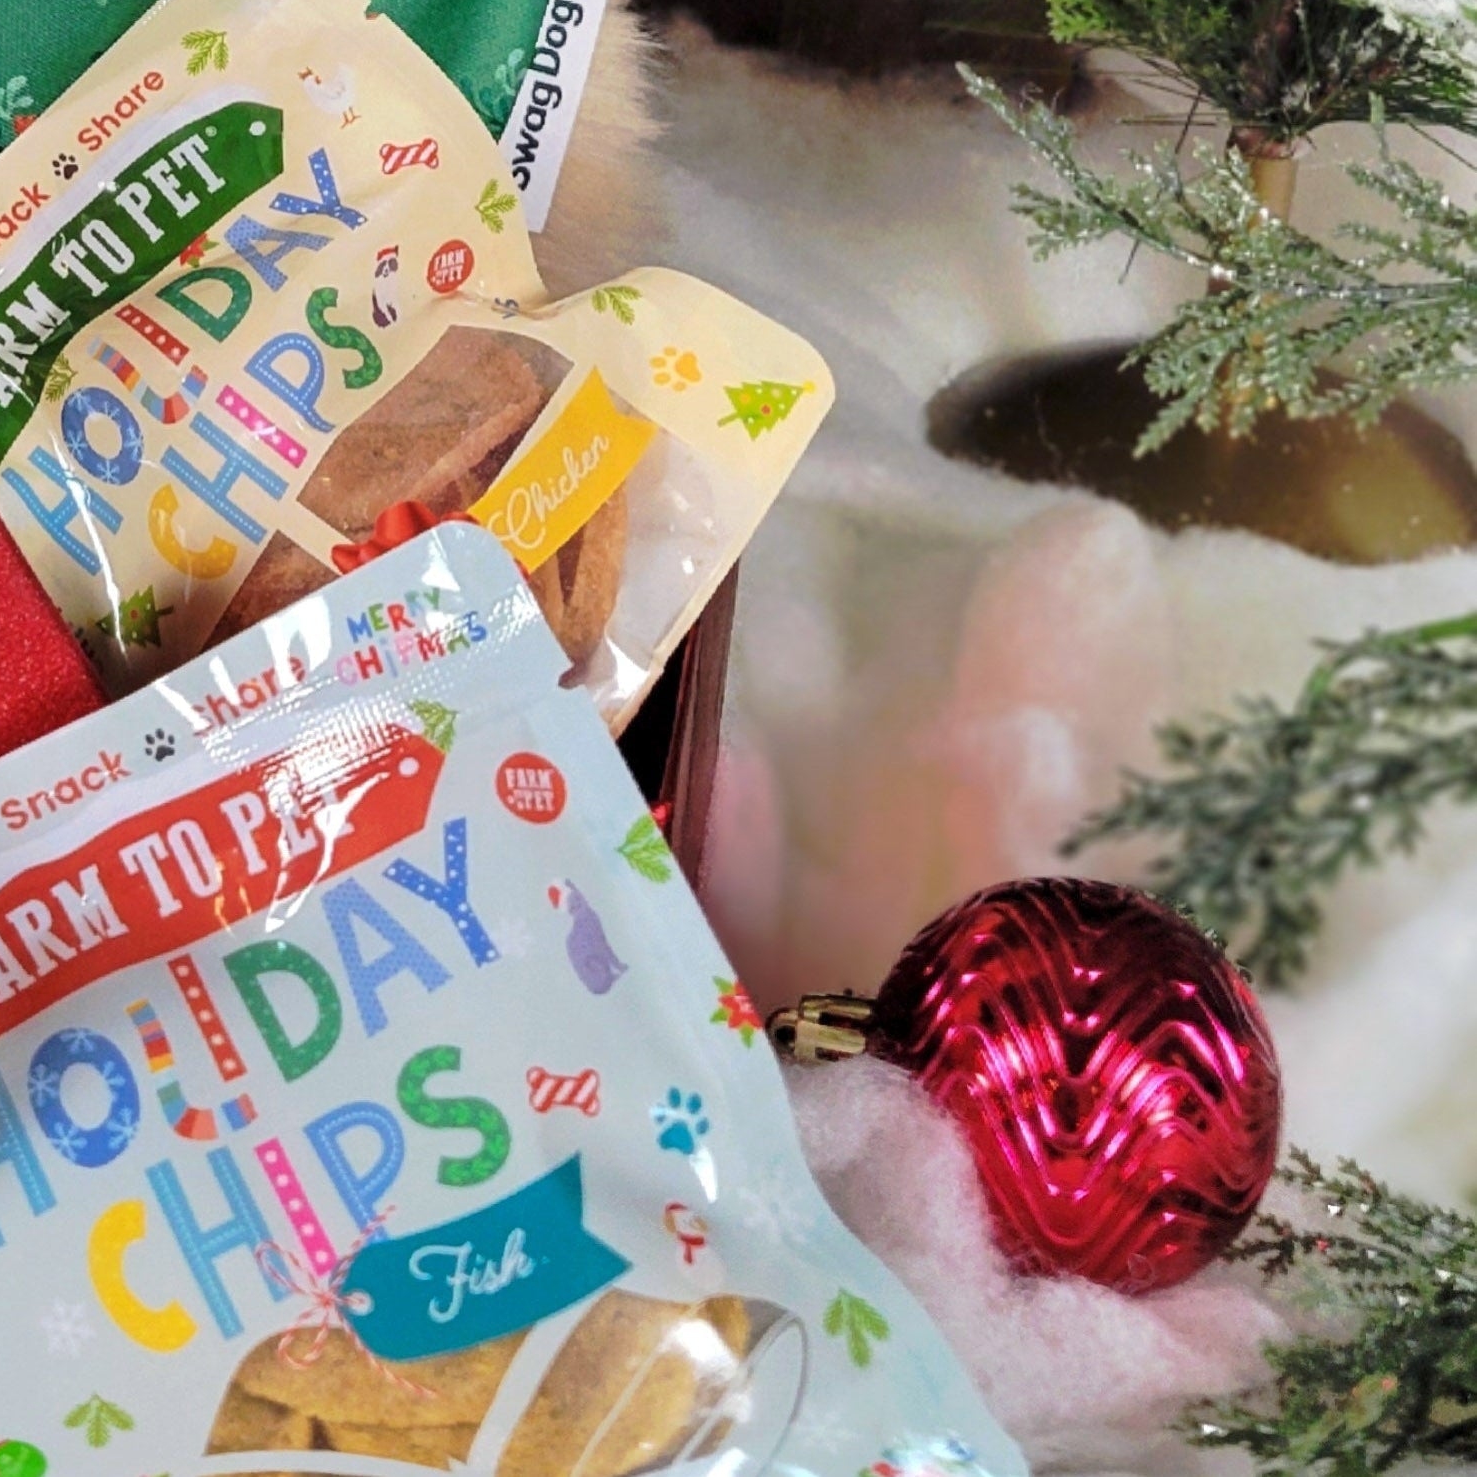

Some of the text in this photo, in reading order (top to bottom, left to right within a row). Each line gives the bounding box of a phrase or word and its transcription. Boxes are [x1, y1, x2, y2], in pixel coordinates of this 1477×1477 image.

[78, 70, 165, 151] Share
[51, 218, 135, 297] TO
[117, 136, 226, 243] PET
[1, 147, 367, 576] HOLIDAY
[148, 286, 383, 580] CHIPS
[487, 435, 609, 549] Chicken
[347, 587, 440, 643] MERRY
[0, 752, 134, 831] Snack
[505, 767, 554, 788] FARM
[121, 818, 223, 920] TO
[87, 1044, 512, 1353] CHIPS
[408, 1226, 536, 1324] Fish
